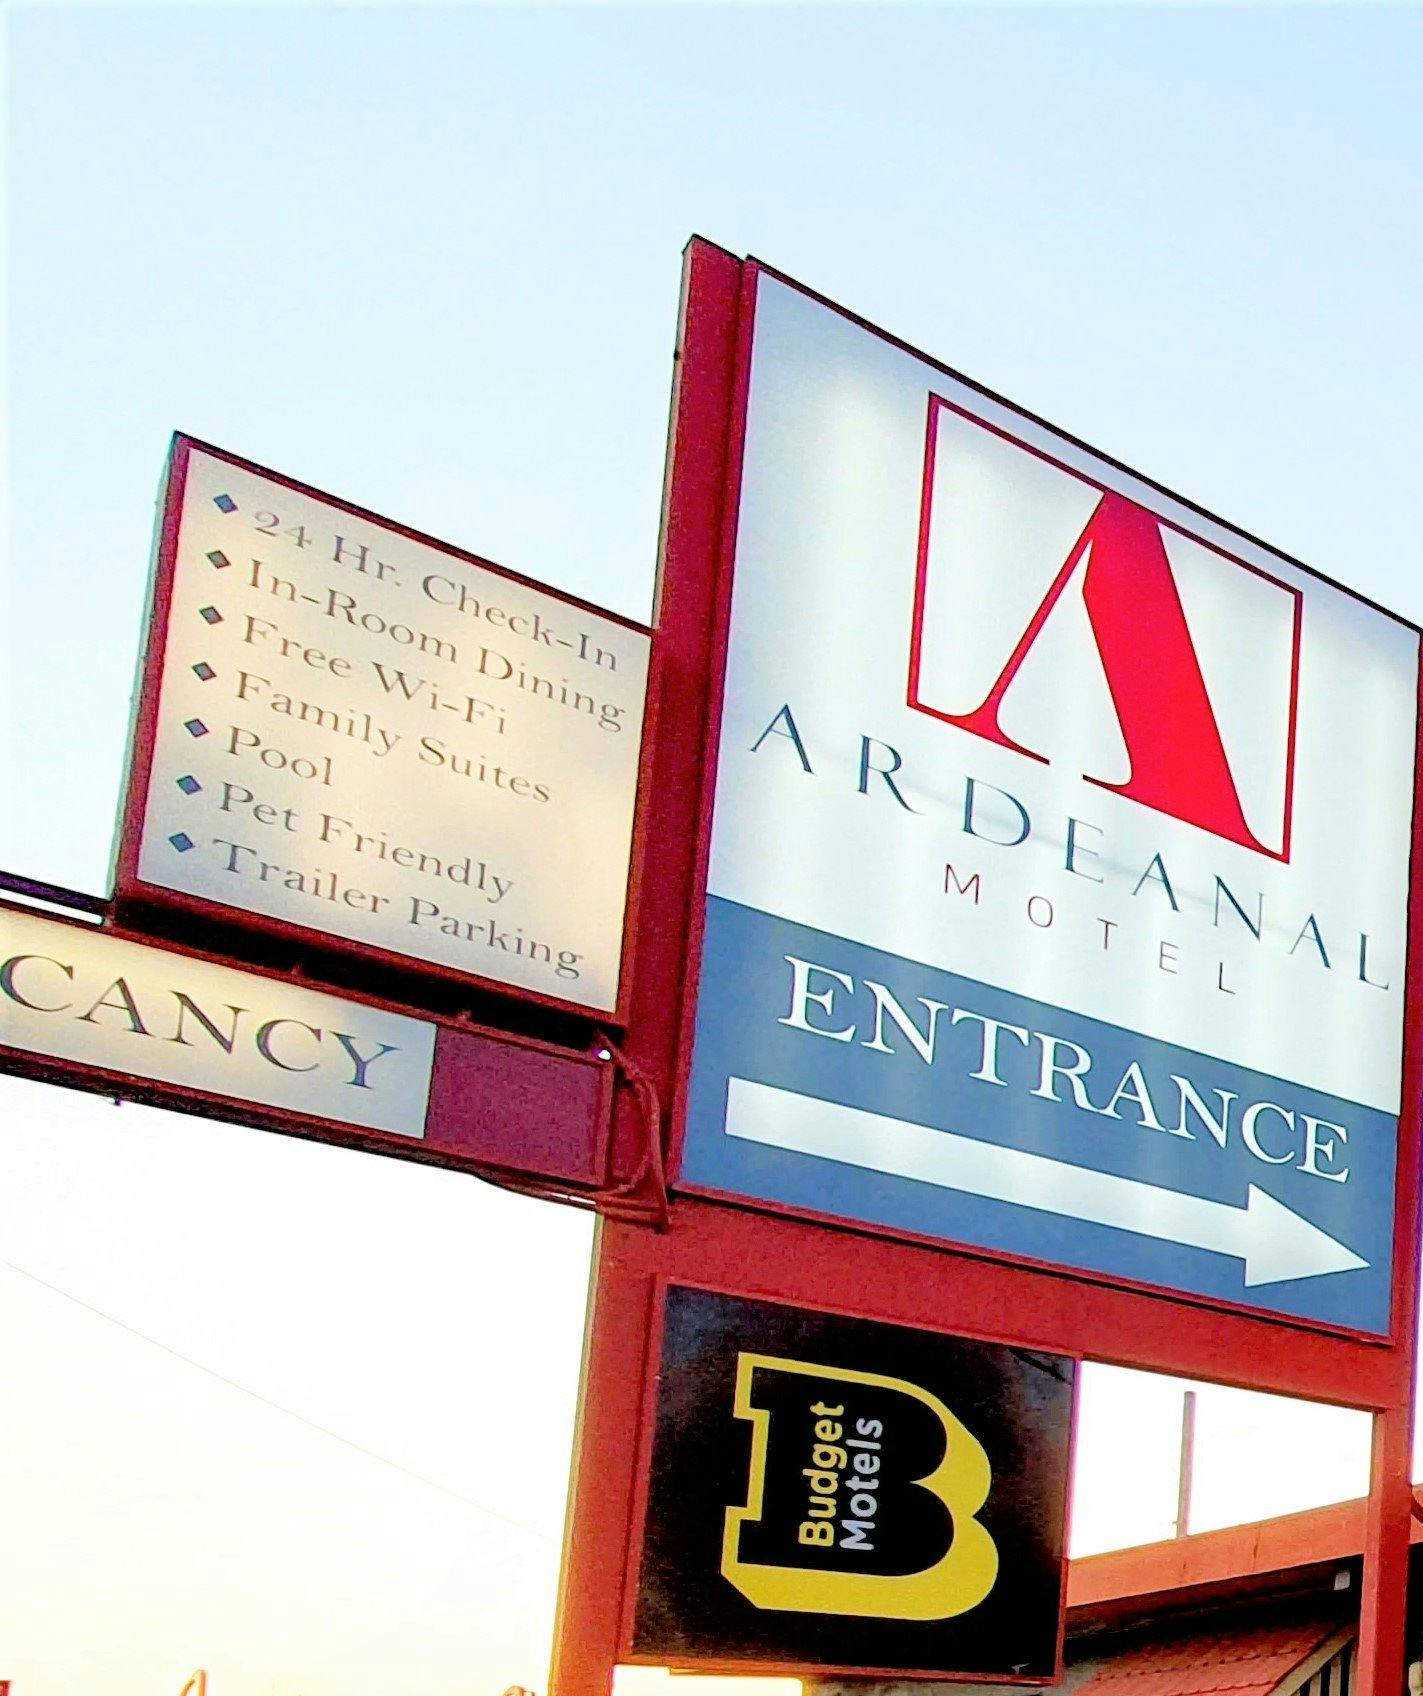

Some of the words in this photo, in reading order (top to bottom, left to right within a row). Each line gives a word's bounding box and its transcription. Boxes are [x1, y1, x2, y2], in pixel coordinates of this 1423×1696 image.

[247, 556, 458, 664] In-Room
[472, 645, 626, 733] Dining
[252, 508, 313, 550] 24
[331, 534, 403, 588] Hr.
[422, 572, 619, 671] Check-In
[235, 669, 401, 756] Family
[418, 736, 551, 804] Suites
[242, 612, 352, 678] Free
[371, 661, 507, 734] Wi-Fi
[226, 725, 333, 786] Pool
[212, 839, 390, 916] Trailer
[408, 897, 583, 981] Parking
[218, 783, 297, 831] Pet
[320, 813, 515, 904] Friendly
[749, 703, 1390, 991] ARDEANAL
[944, 864, 1236, 994] MOTEL
[0, 954, 399, 1089] CANCY
[777, 956, 1350, 1182] ENTRANCE
[798, 1401, 848, 1547] Budget
[839, 1417, 884, 1551] Motels
